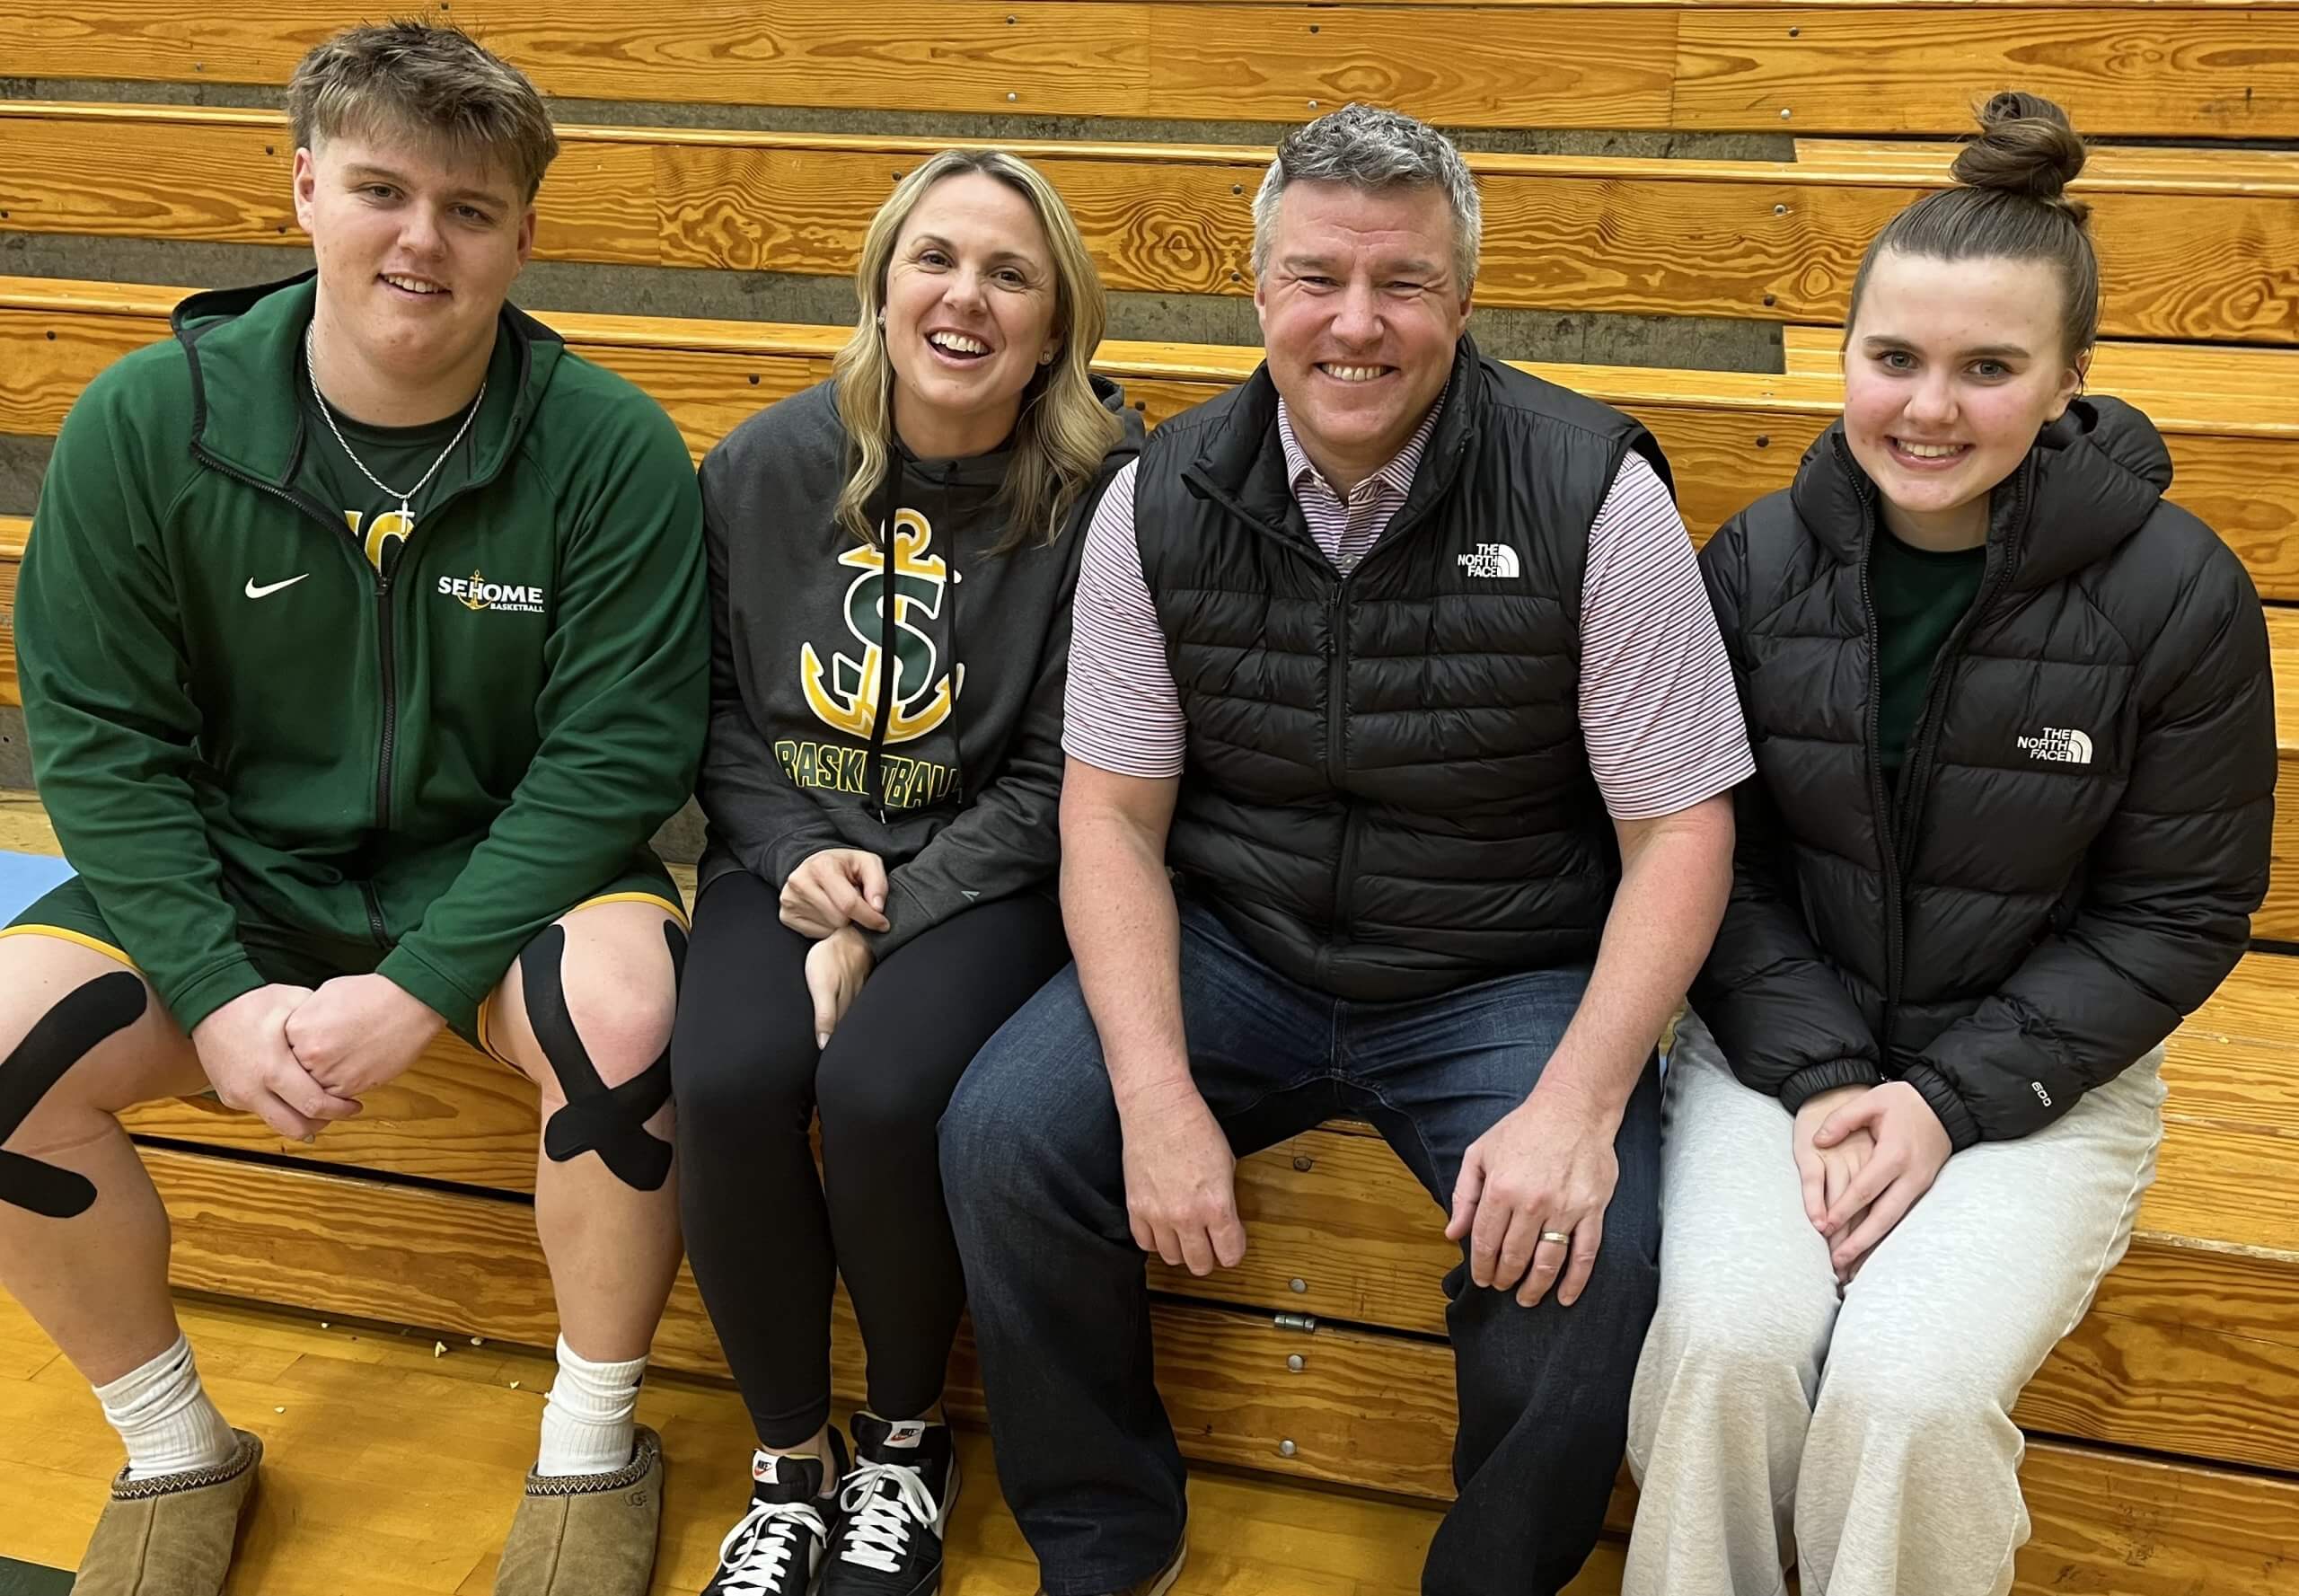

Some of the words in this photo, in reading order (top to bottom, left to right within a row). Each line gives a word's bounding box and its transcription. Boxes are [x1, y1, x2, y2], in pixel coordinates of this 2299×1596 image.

[1476, 543, 1499, 555] THE
[1458, 554, 1498, 566] NORTH
[1467, 565, 1497, 578] FACE
[437, 575, 544, 604] SEHOME
[489, 602, 545, 613] BASKETBALL
[2042, 727, 2071, 740] THE
[2017, 736, 2068, 752] NORTH
[2030, 748, 2067, 762] FACE
[2031, 1081, 2052, 1107] 600
